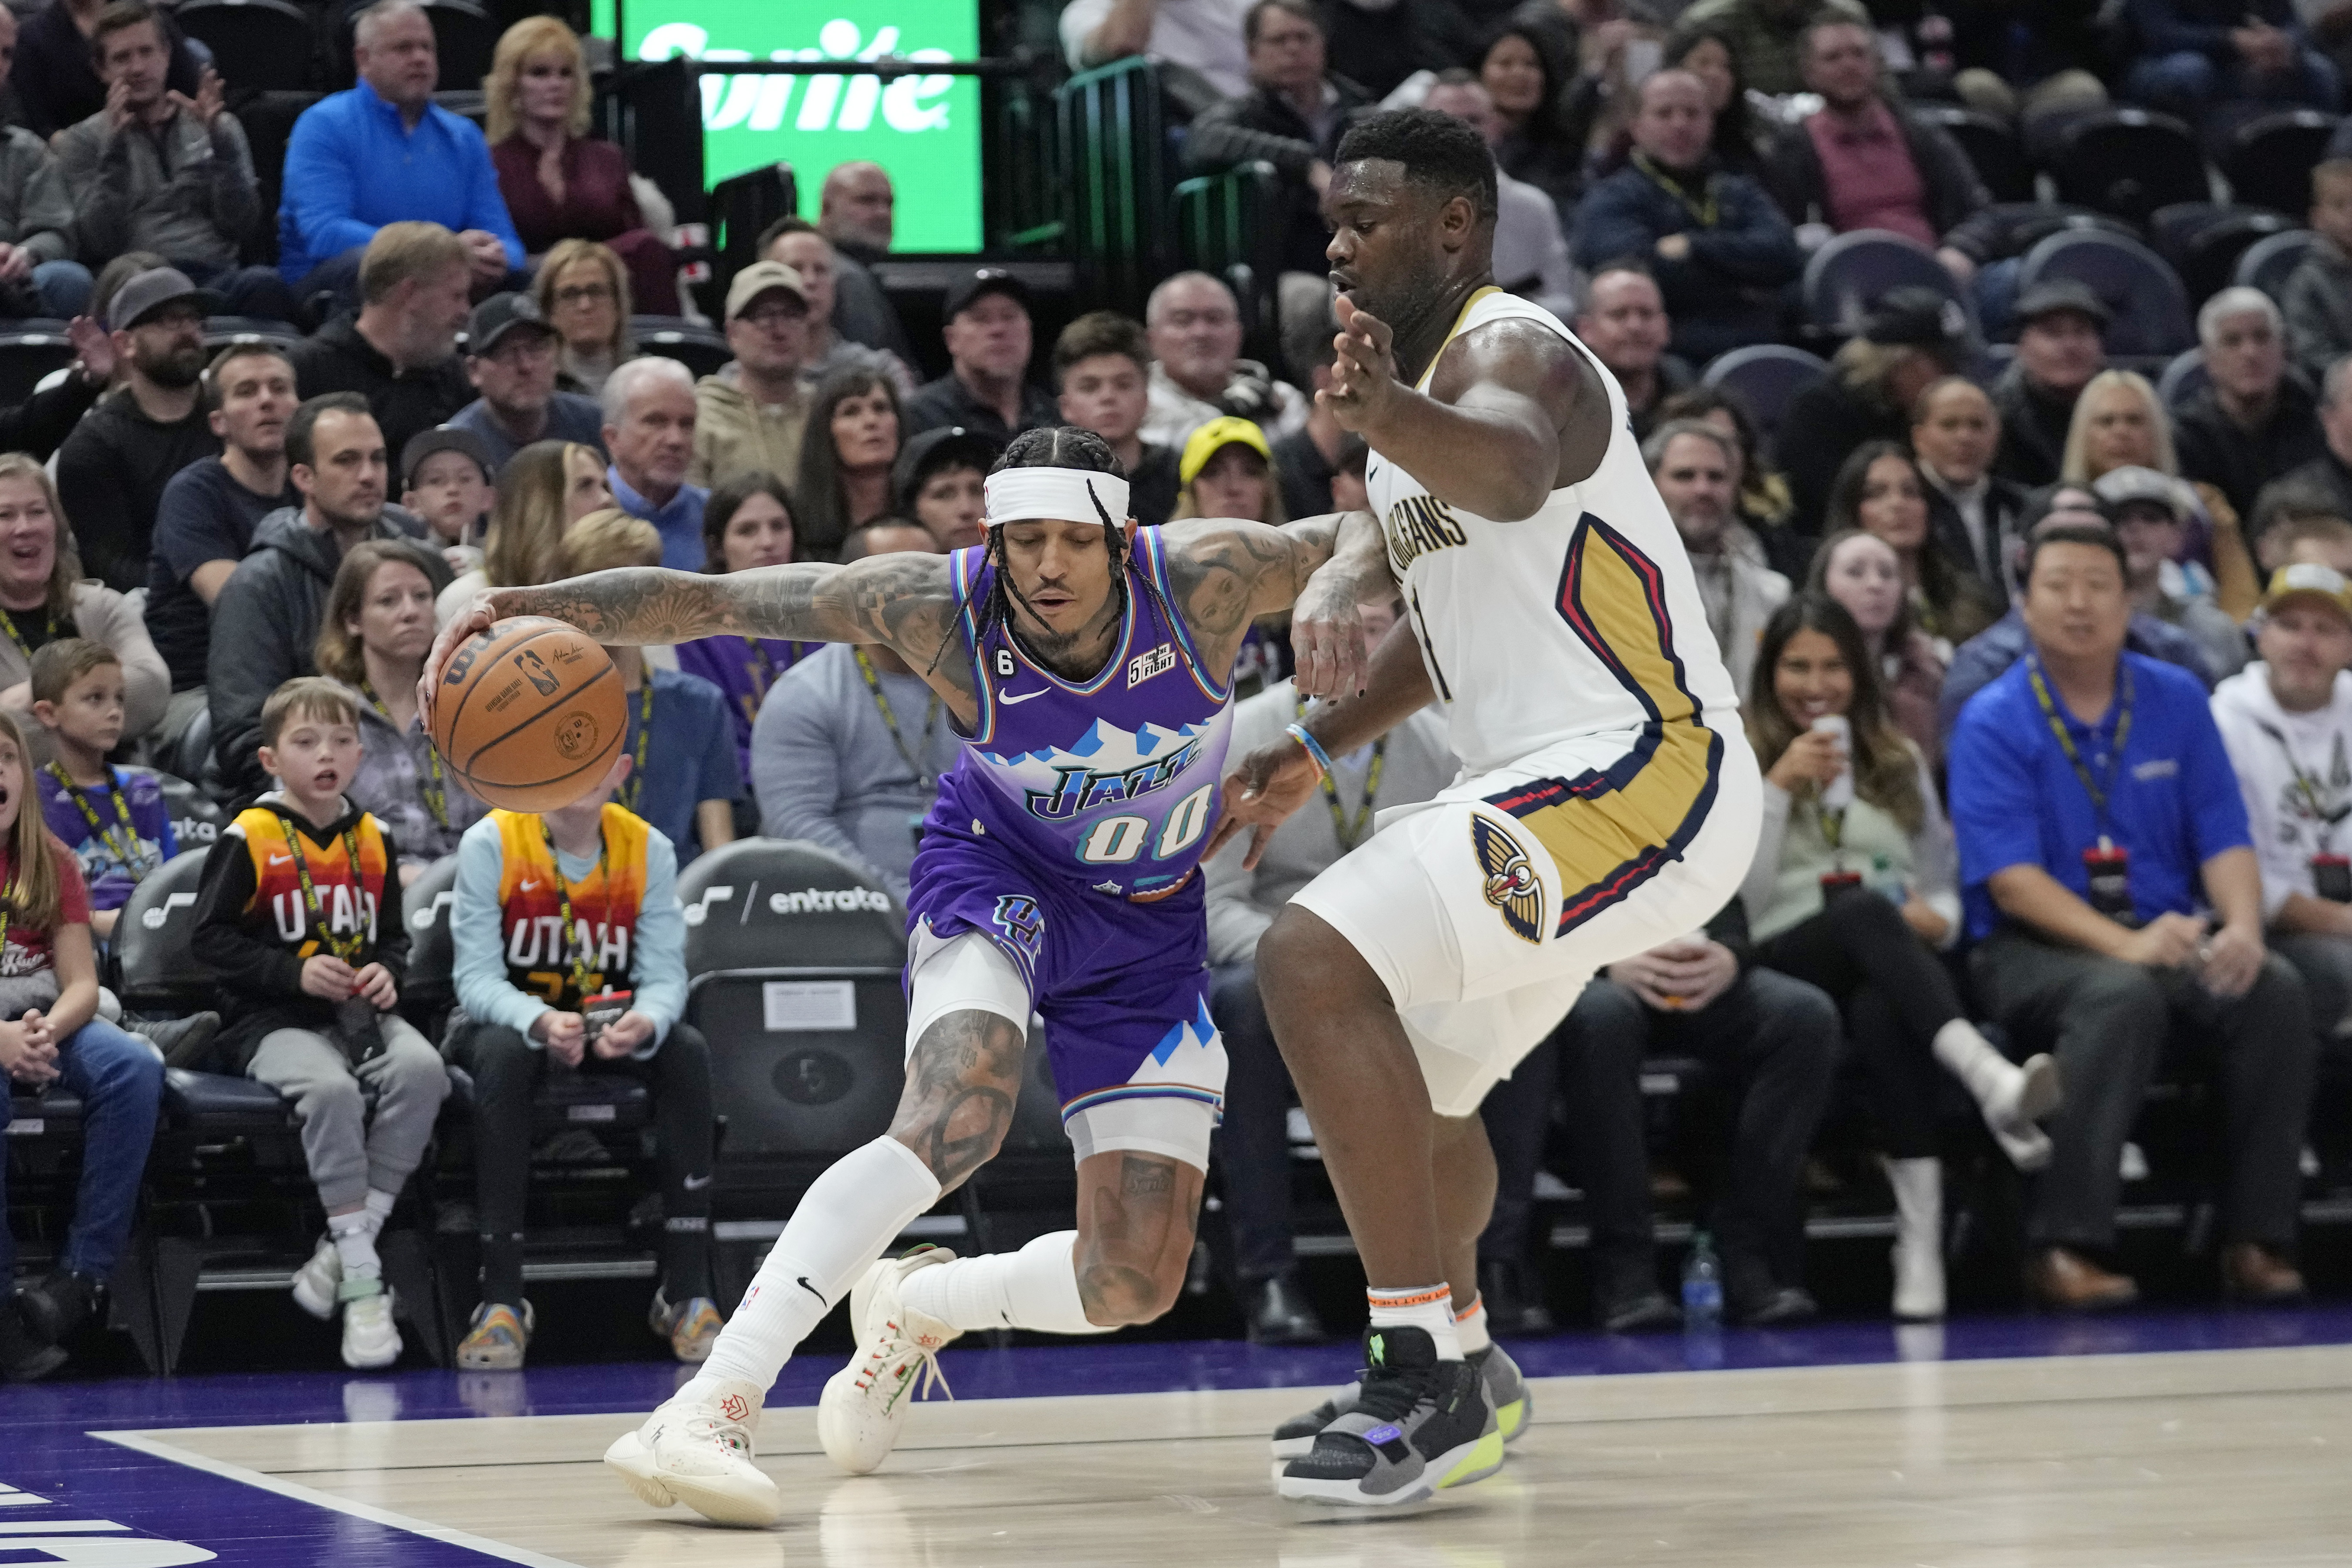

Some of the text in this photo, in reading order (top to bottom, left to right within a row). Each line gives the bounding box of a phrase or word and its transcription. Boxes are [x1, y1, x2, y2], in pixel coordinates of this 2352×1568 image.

[997, 650, 1014, 674] 6
[1130, 659, 1139, 683] 5
[1145, 656, 1172, 676] FIGHT
[1024, 737, 1205, 822] JAZZ
[1075, 783, 1216, 864] 00
[273, 884, 377, 944] UTAH
[769, 885, 891, 914] entrata
[508, 915, 629, 971] UTAH
